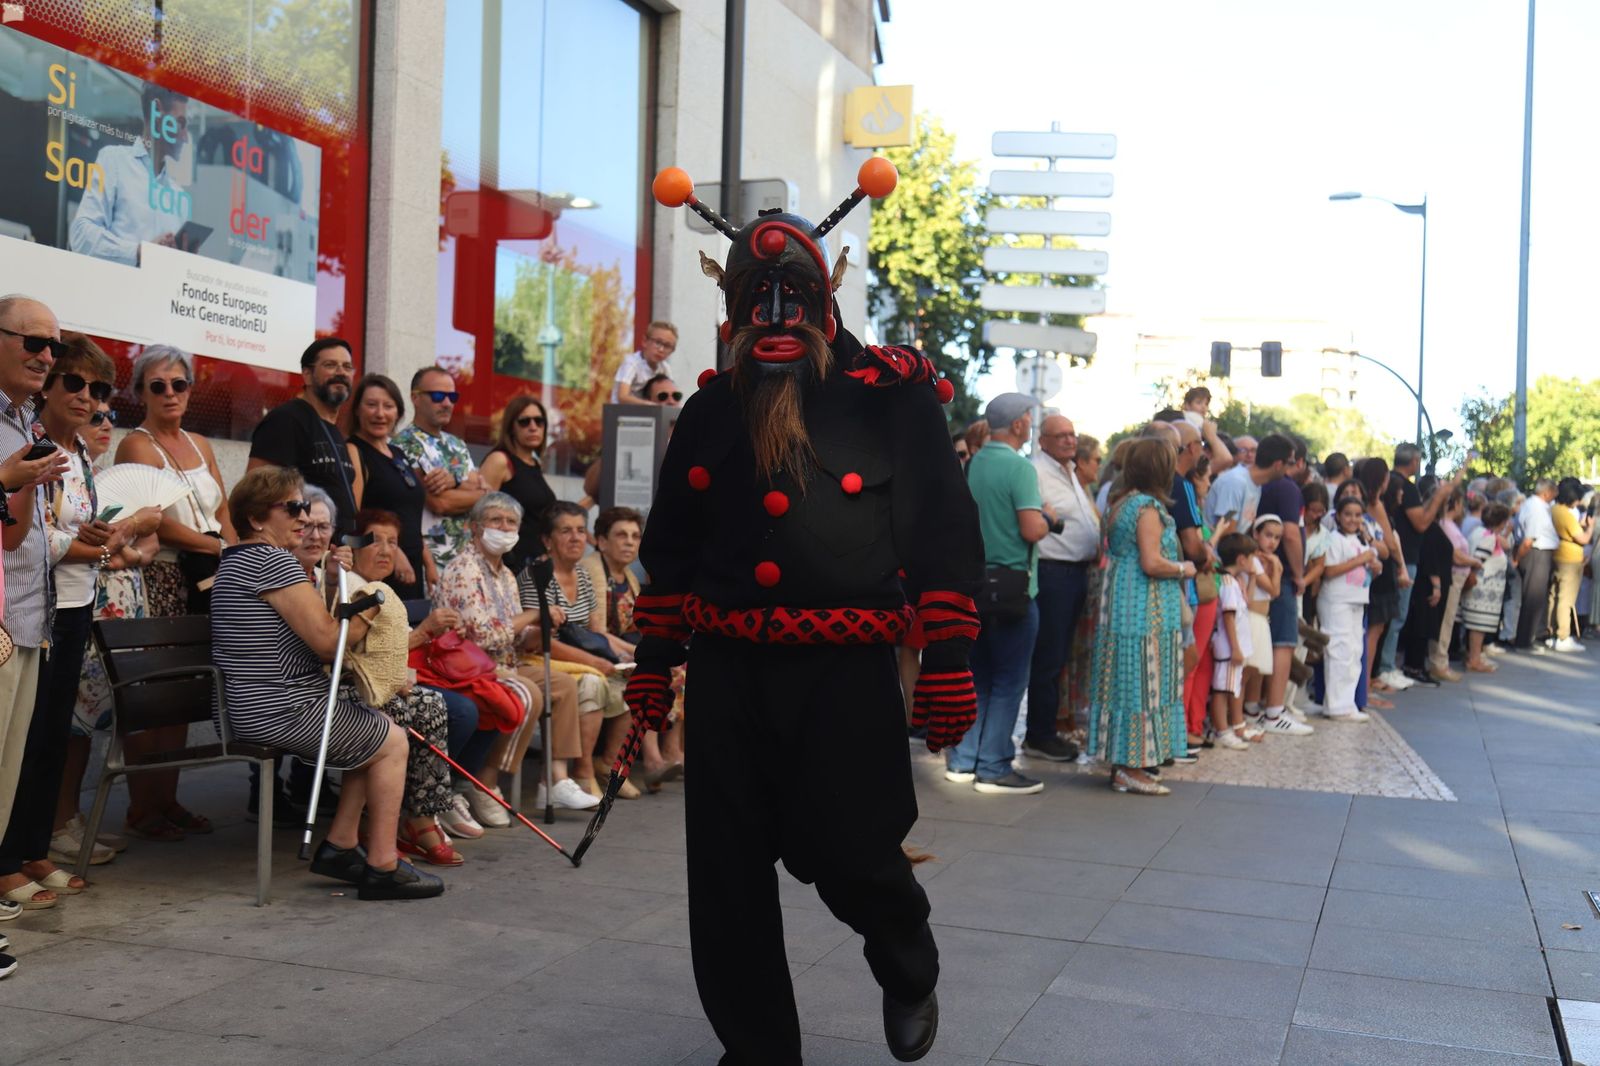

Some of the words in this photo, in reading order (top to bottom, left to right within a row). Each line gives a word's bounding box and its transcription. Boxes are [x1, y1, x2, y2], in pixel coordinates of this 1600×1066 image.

[48, 64, 76, 109] Si
[151, 99, 177, 144] te
[232, 136, 263, 175] da
[45, 141, 105, 193] San
[149, 172, 193, 220] tan
[229, 202, 271, 241] der
[170, 299, 196, 319] Next
[199, 306, 267, 333] GenerationEU
[182, 283, 219, 304] Fondos
[222, 292, 268, 316] Europeos
